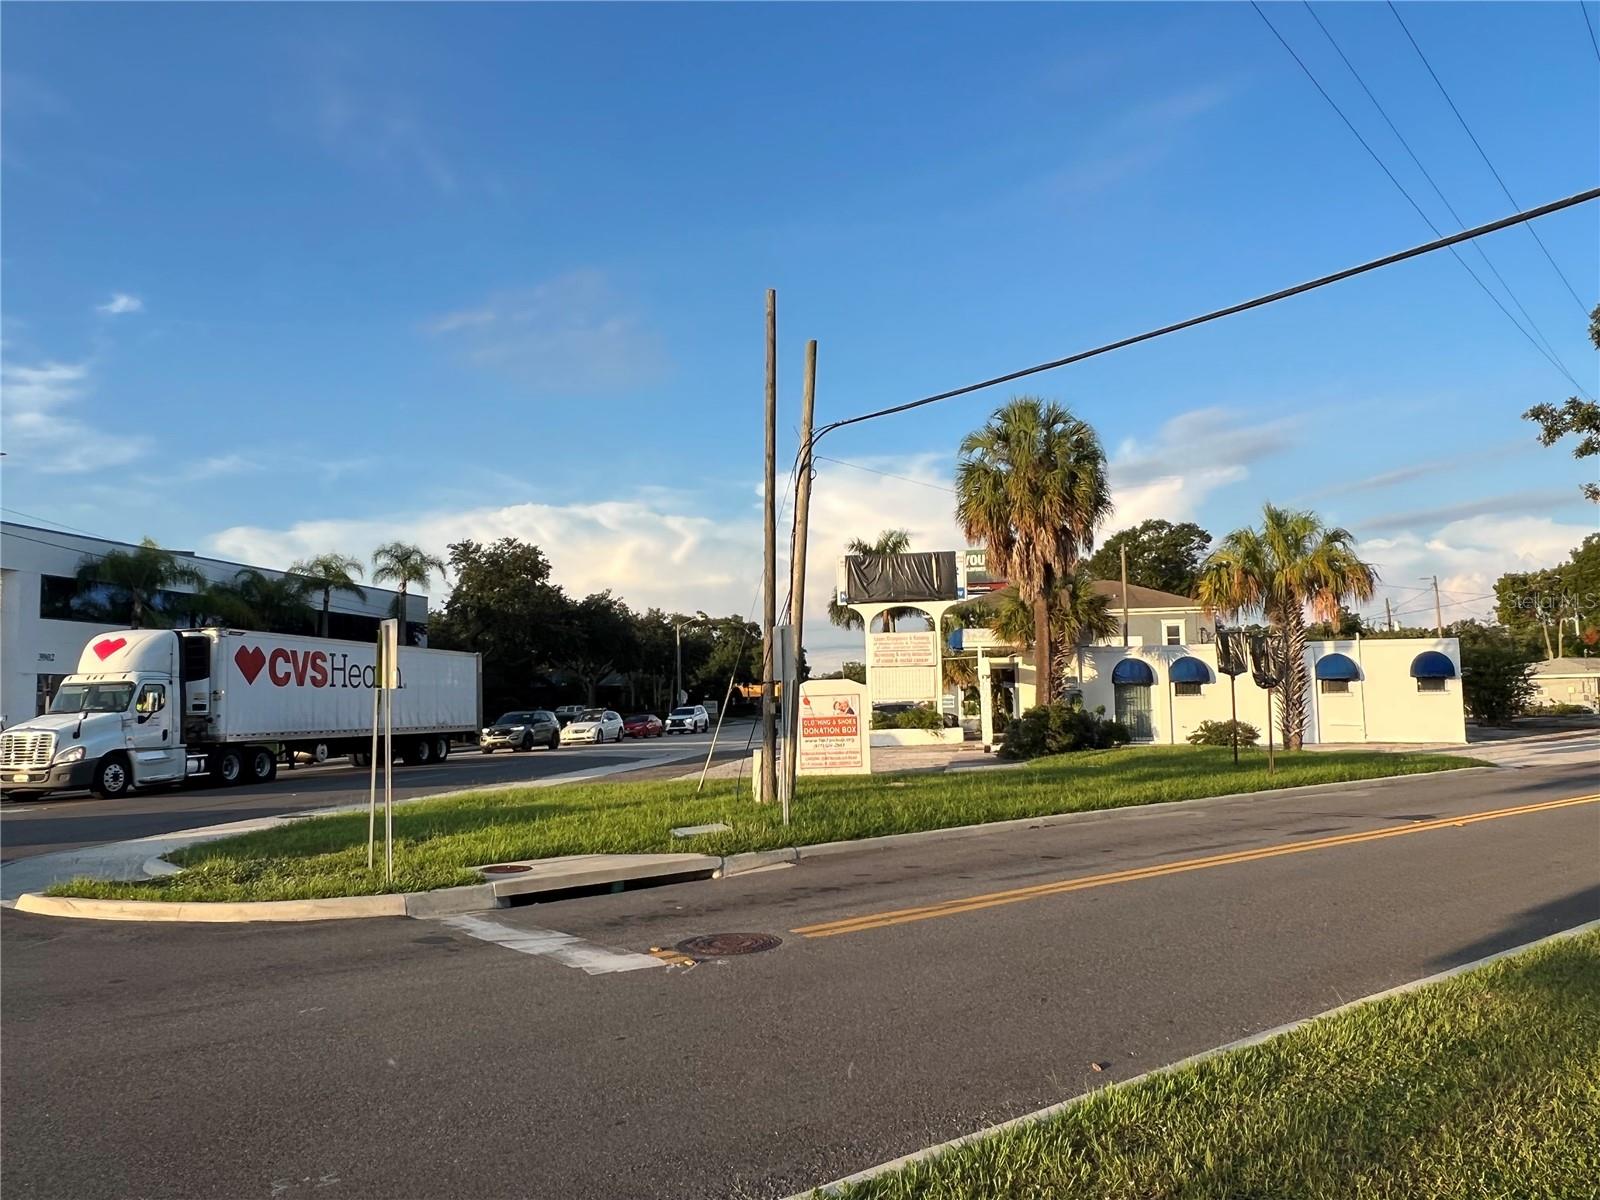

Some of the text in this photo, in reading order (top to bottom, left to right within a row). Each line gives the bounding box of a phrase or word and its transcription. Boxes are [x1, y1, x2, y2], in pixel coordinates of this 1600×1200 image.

[268, 648, 403, 689] CVS Hea
[803, 726, 857, 735] DONATION BOX
